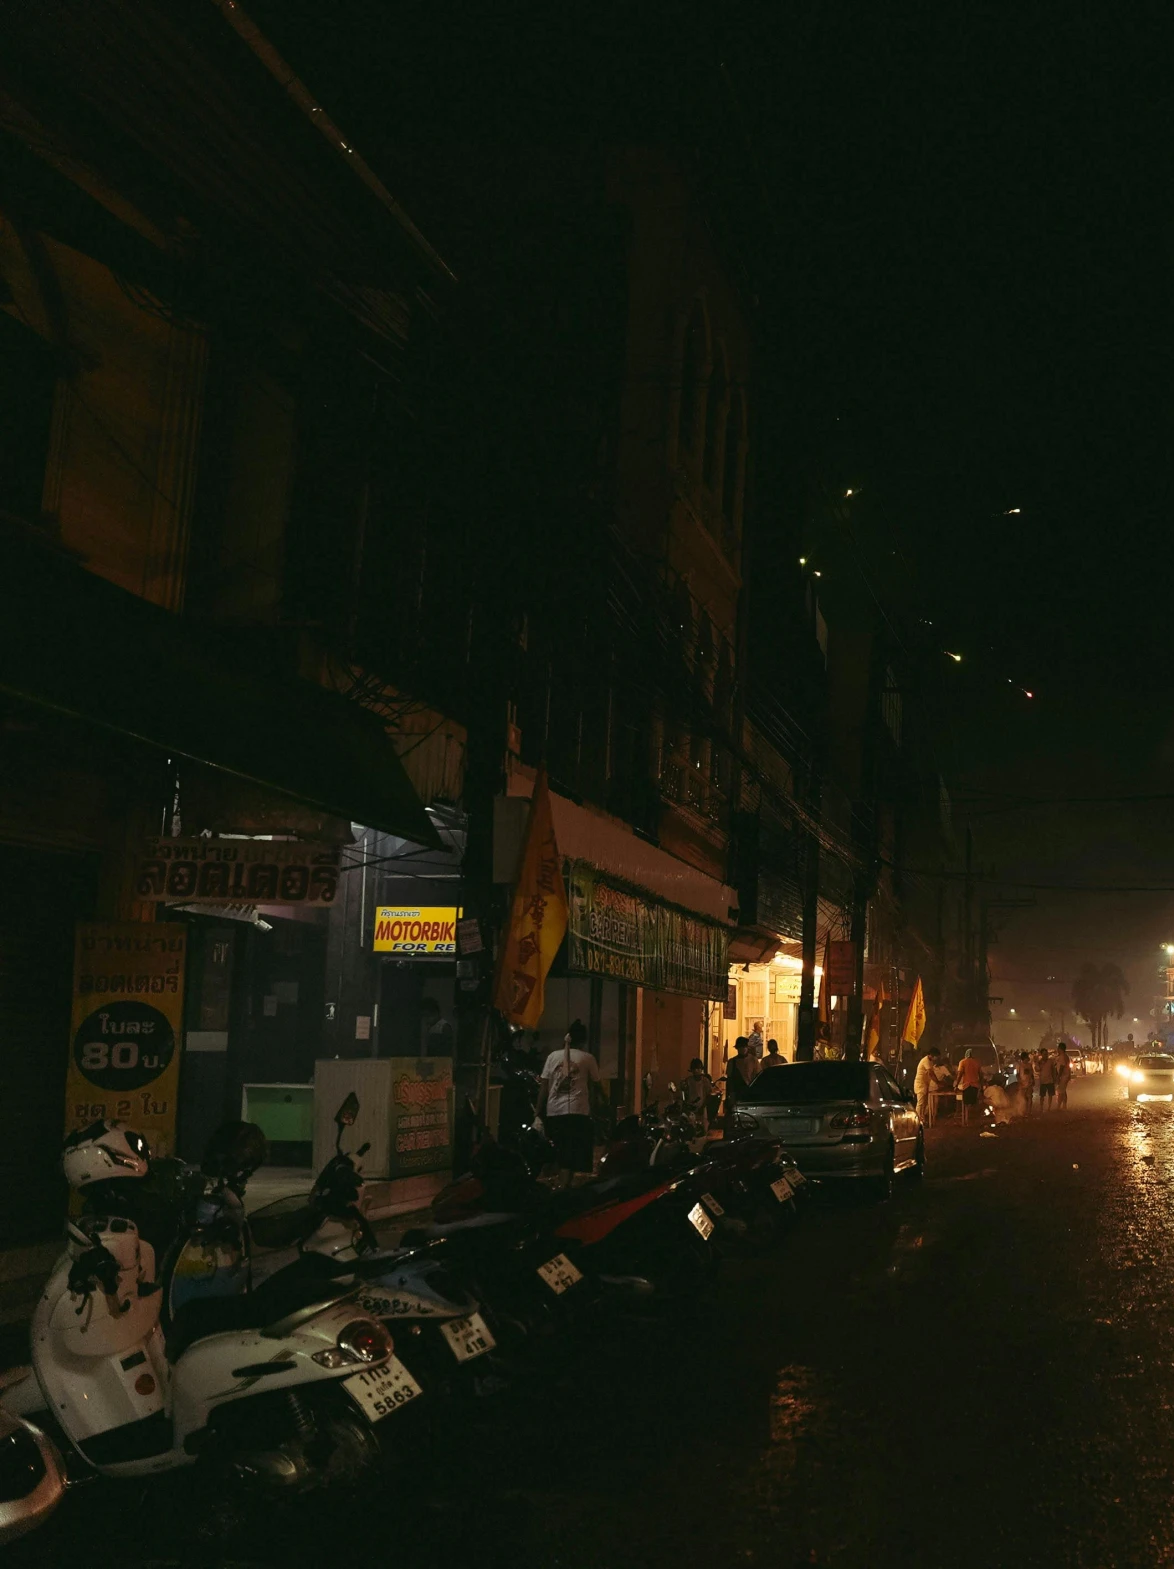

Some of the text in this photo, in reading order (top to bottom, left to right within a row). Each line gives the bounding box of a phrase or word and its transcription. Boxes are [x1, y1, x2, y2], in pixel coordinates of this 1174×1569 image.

[375, 921, 456, 941] MOTORBIK
[392, 943, 427, 951] FOR
[99, 1012, 156, 1035] ใบละ
[81, 1042, 139, 1071] 80
[117, 1099, 131, 1117] 2
[140, 1093, 168, 1115] ใบ
[374, 1385, 413, 1414] 5863
